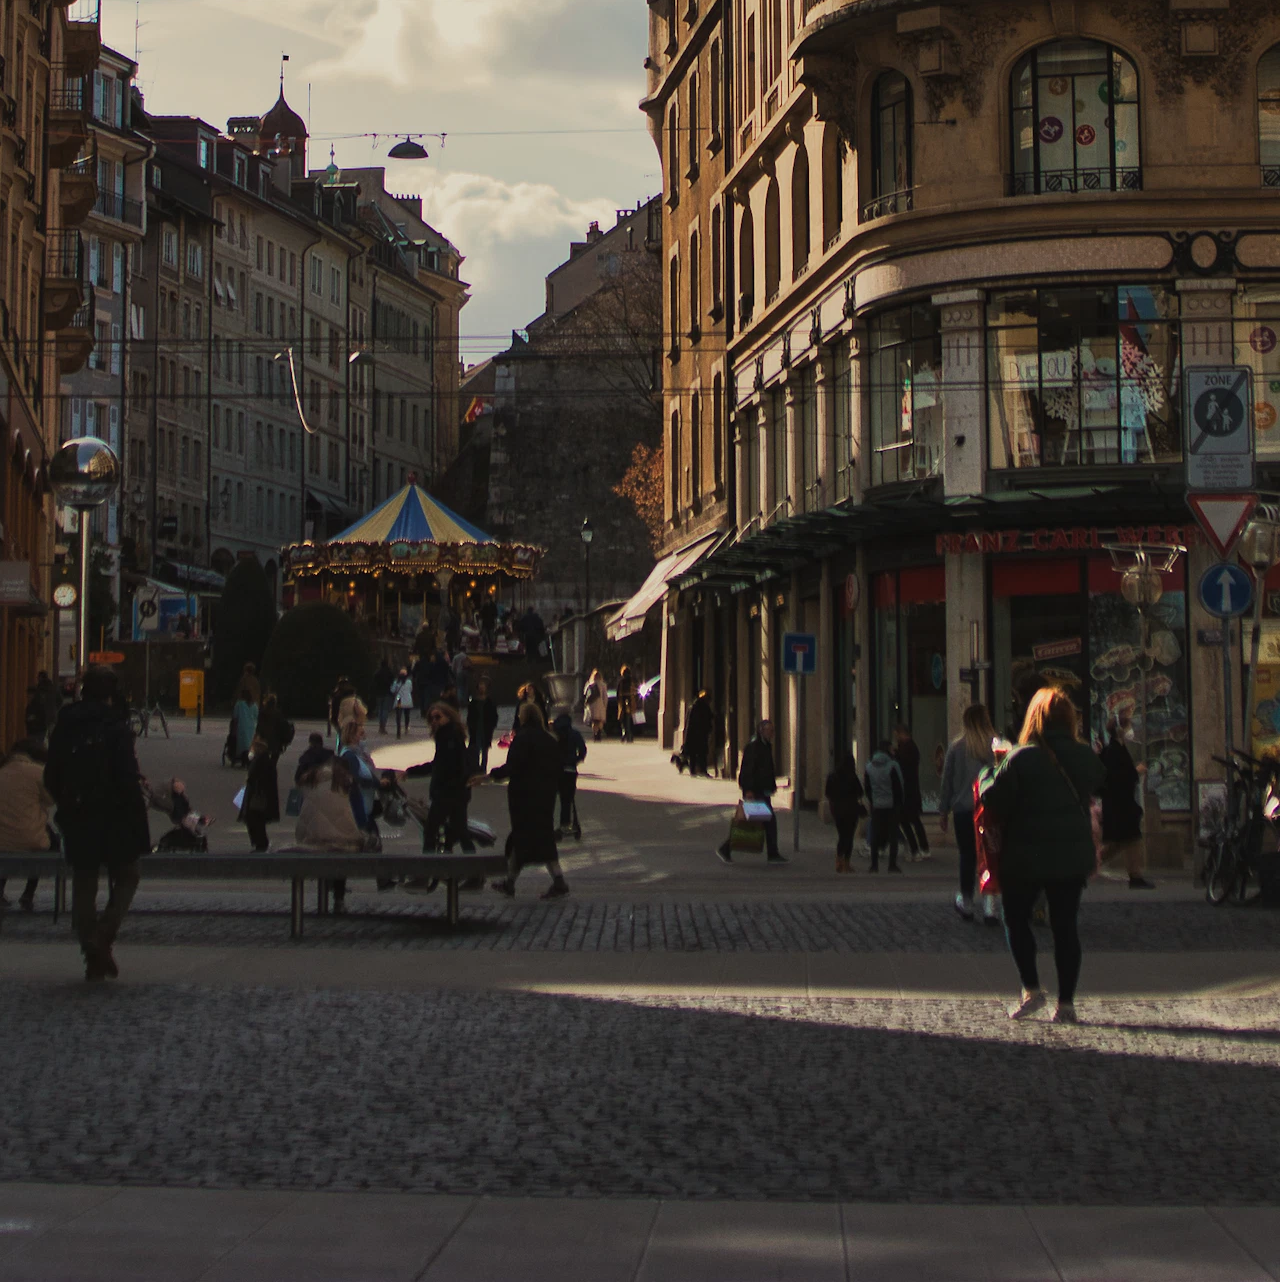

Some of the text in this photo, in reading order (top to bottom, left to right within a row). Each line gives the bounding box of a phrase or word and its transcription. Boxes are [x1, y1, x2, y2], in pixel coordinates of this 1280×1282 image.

[1204, 374, 1233, 386] ZONE
[935, 530, 1021, 556] FRANZ
[1031, 527, 1101, 550] CARL
